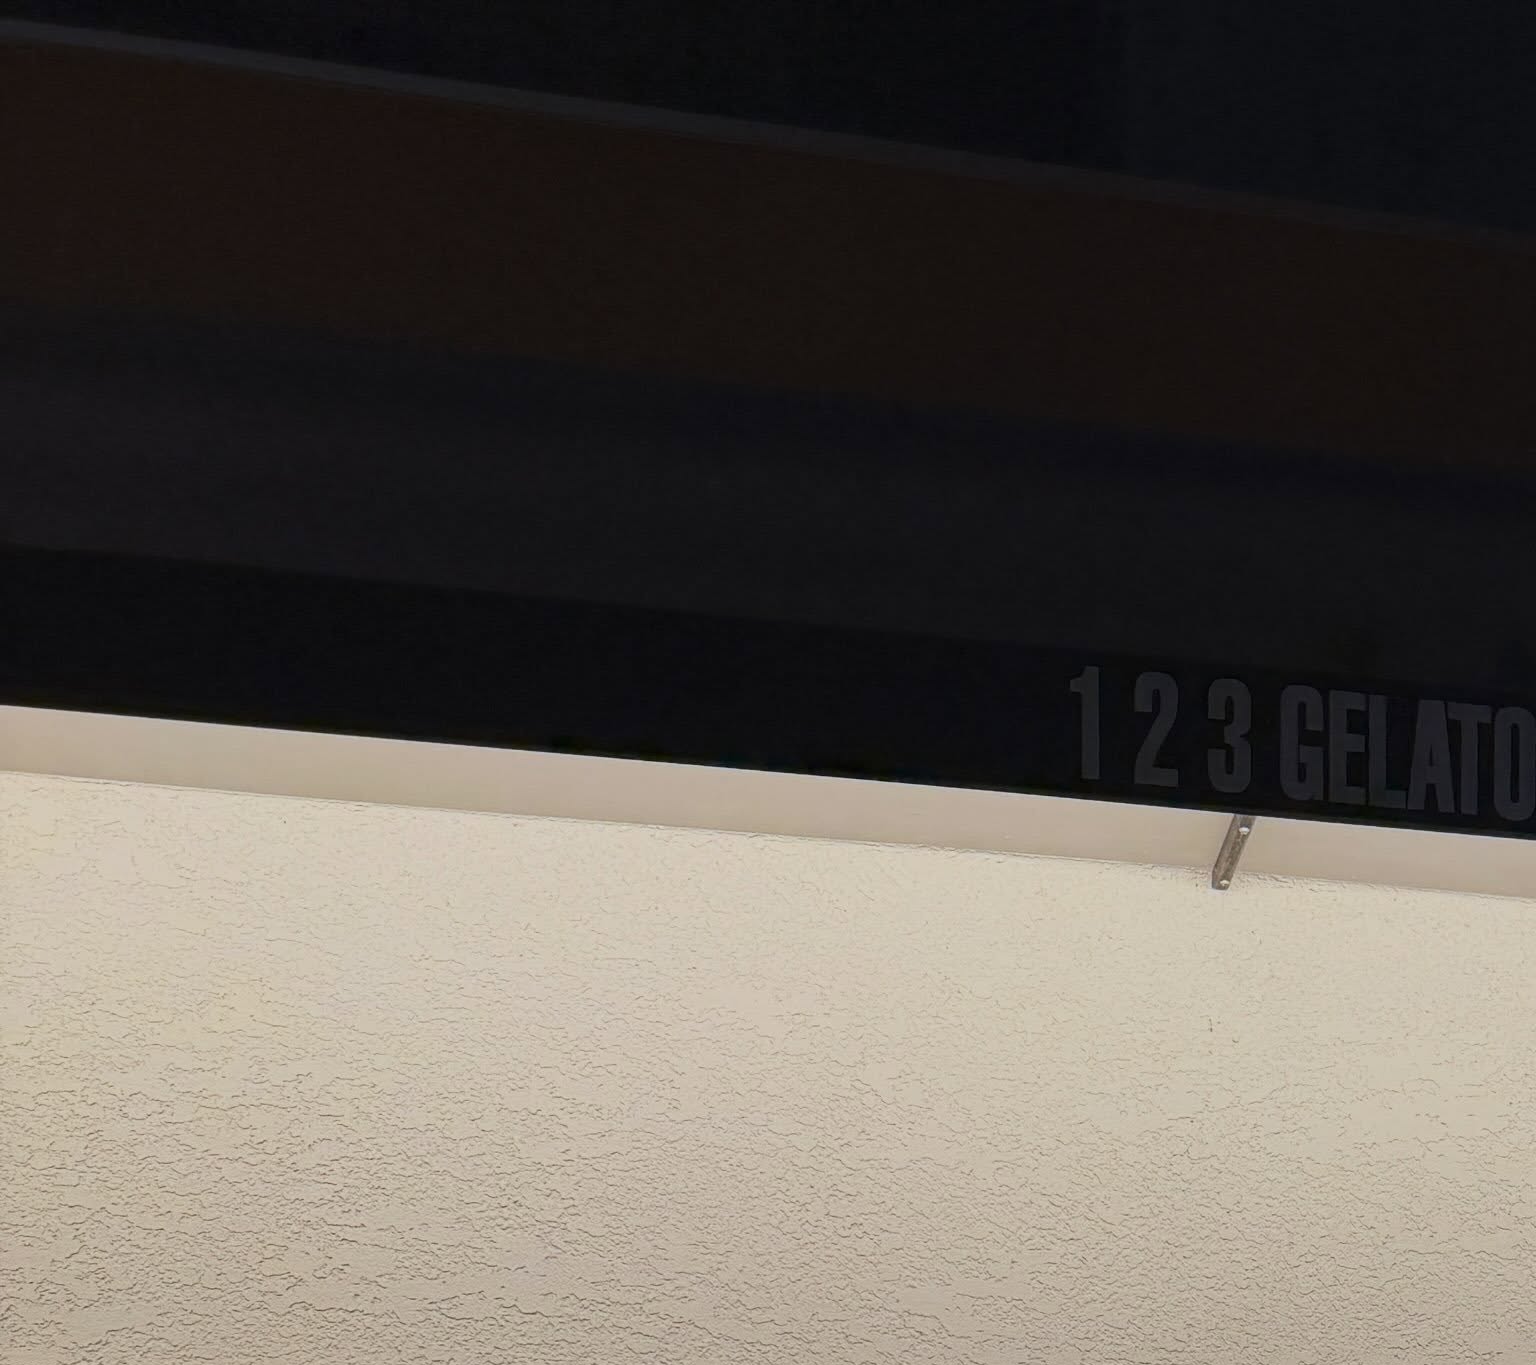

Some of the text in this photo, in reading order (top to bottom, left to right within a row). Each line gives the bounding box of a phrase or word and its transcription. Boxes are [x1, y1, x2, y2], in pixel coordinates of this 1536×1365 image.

[1070, 666, 1536, 821] 1 2 3 GELATO
